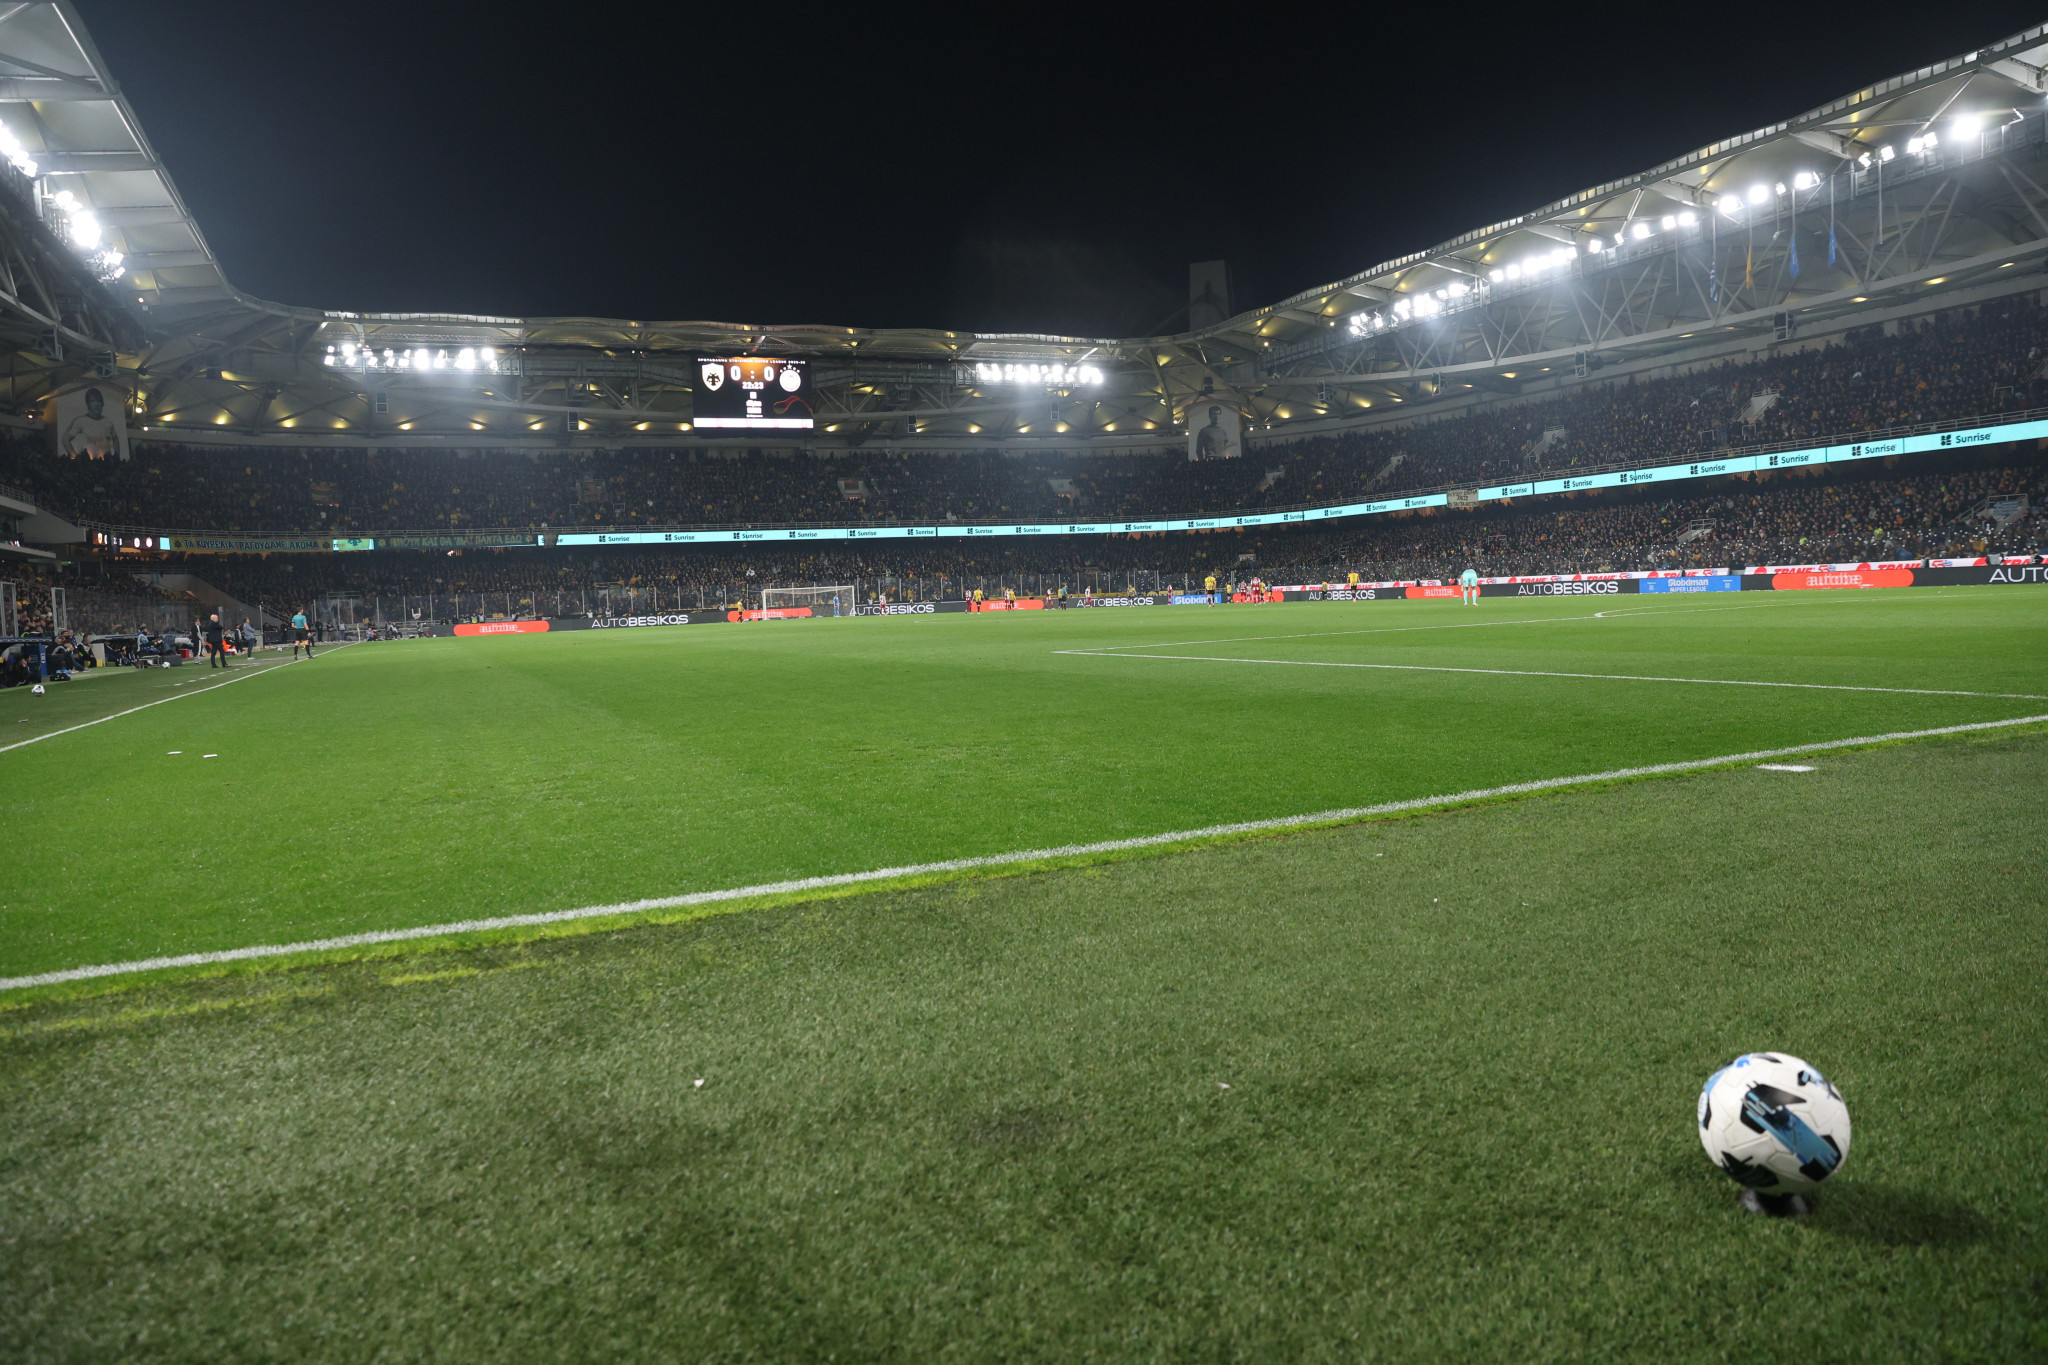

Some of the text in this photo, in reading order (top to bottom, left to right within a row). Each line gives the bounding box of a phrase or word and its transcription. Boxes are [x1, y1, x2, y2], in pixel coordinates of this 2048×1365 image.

[730, 365, 741, 381] 0
[763, 366, 774, 381] 0
[1956, 433, 1991, 444] Sunrise
[1865, 444, 1896, 454] Sunrise
[1781, 454, 1809, 464] Sunrise
[1701, 464, 1726, 473] Sunrise
[1630, 473, 1652, 481] Sunrise
[1572, 480, 1592, 488] Sunrise
[1509, 487, 1527, 495] Sunrise
[504, 534, 522, 543] ΕΔΩ
[184, 540, 319, 550] ΤΑ ΚΟΥΡΕΛΙΑ ΤΡΑΓΟΥΔΑΝΕ ΑΚΟΜΑ
[1518, 581, 1619, 595] AUTOBESIKOS
[591, 614, 689, 629] AUTOBESIKOS
